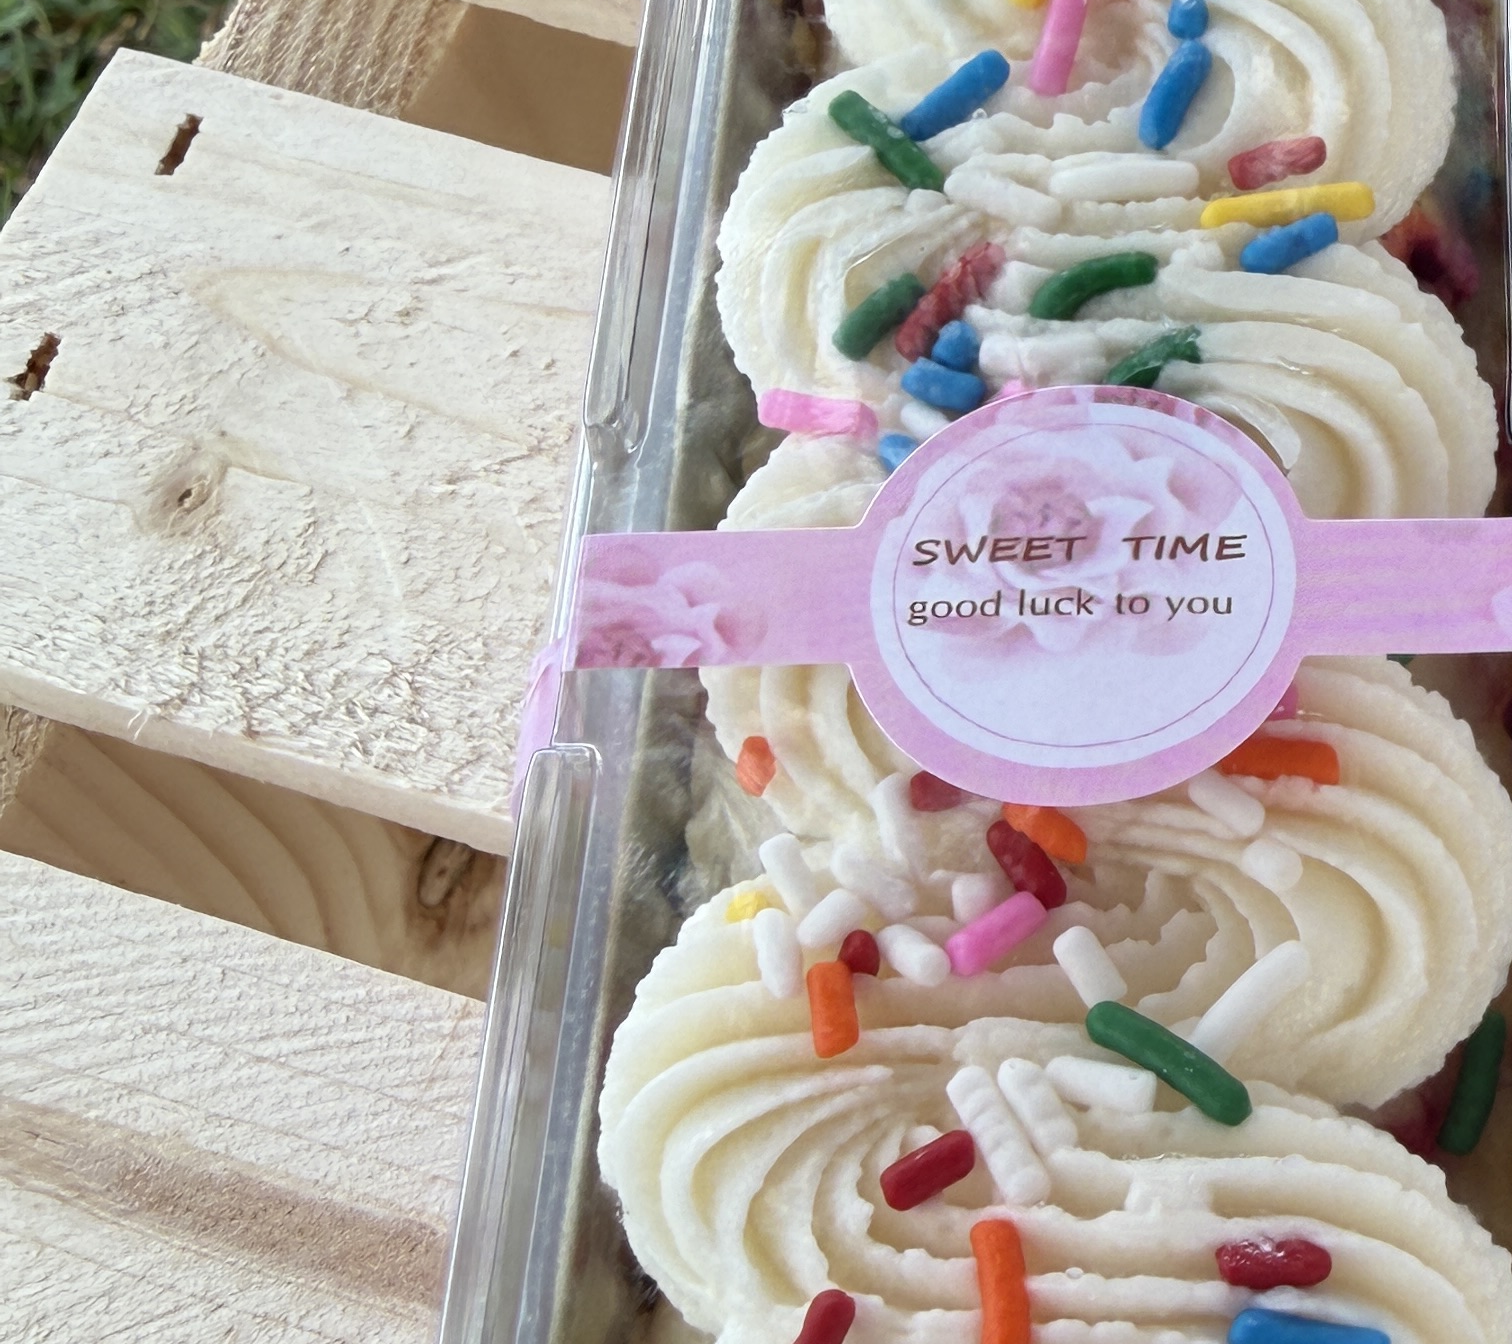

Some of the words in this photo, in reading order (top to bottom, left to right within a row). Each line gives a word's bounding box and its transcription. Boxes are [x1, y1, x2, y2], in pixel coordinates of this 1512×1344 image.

[913, 535, 1088, 567] SWEET
[1122, 533, 1249, 562] TIME
[907, 590, 1002, 627] good
[1018, 588, 1095, 616] luck
[1115, 592, 1151, 616] to
[1165, 594, 1234, 622] you
